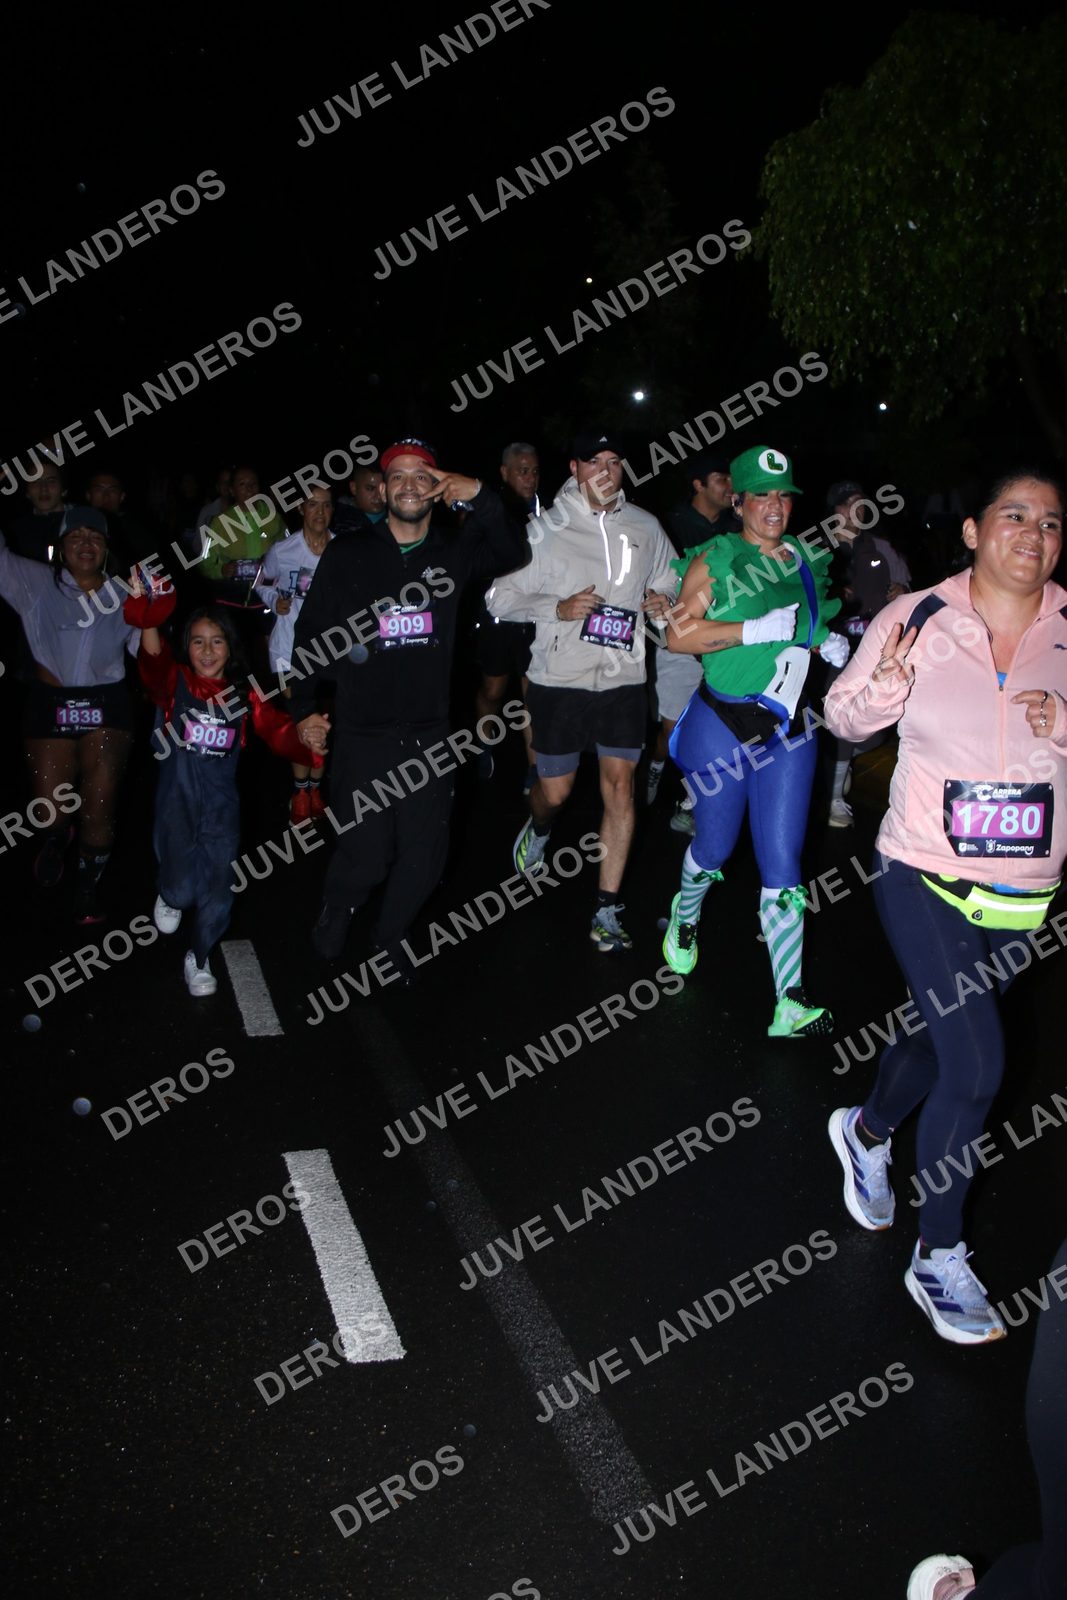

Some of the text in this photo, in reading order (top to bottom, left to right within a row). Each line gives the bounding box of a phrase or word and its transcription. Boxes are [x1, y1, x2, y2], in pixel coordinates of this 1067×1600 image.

[766, 452, 784, 471] L
[388, 615, 425, 636] 909
[592, 616, 631, 638] 1697
[59, 709, 102, 723] 1838
[192, 724, 228, 747] 908
[957, 803, 1041, 836] 1780
